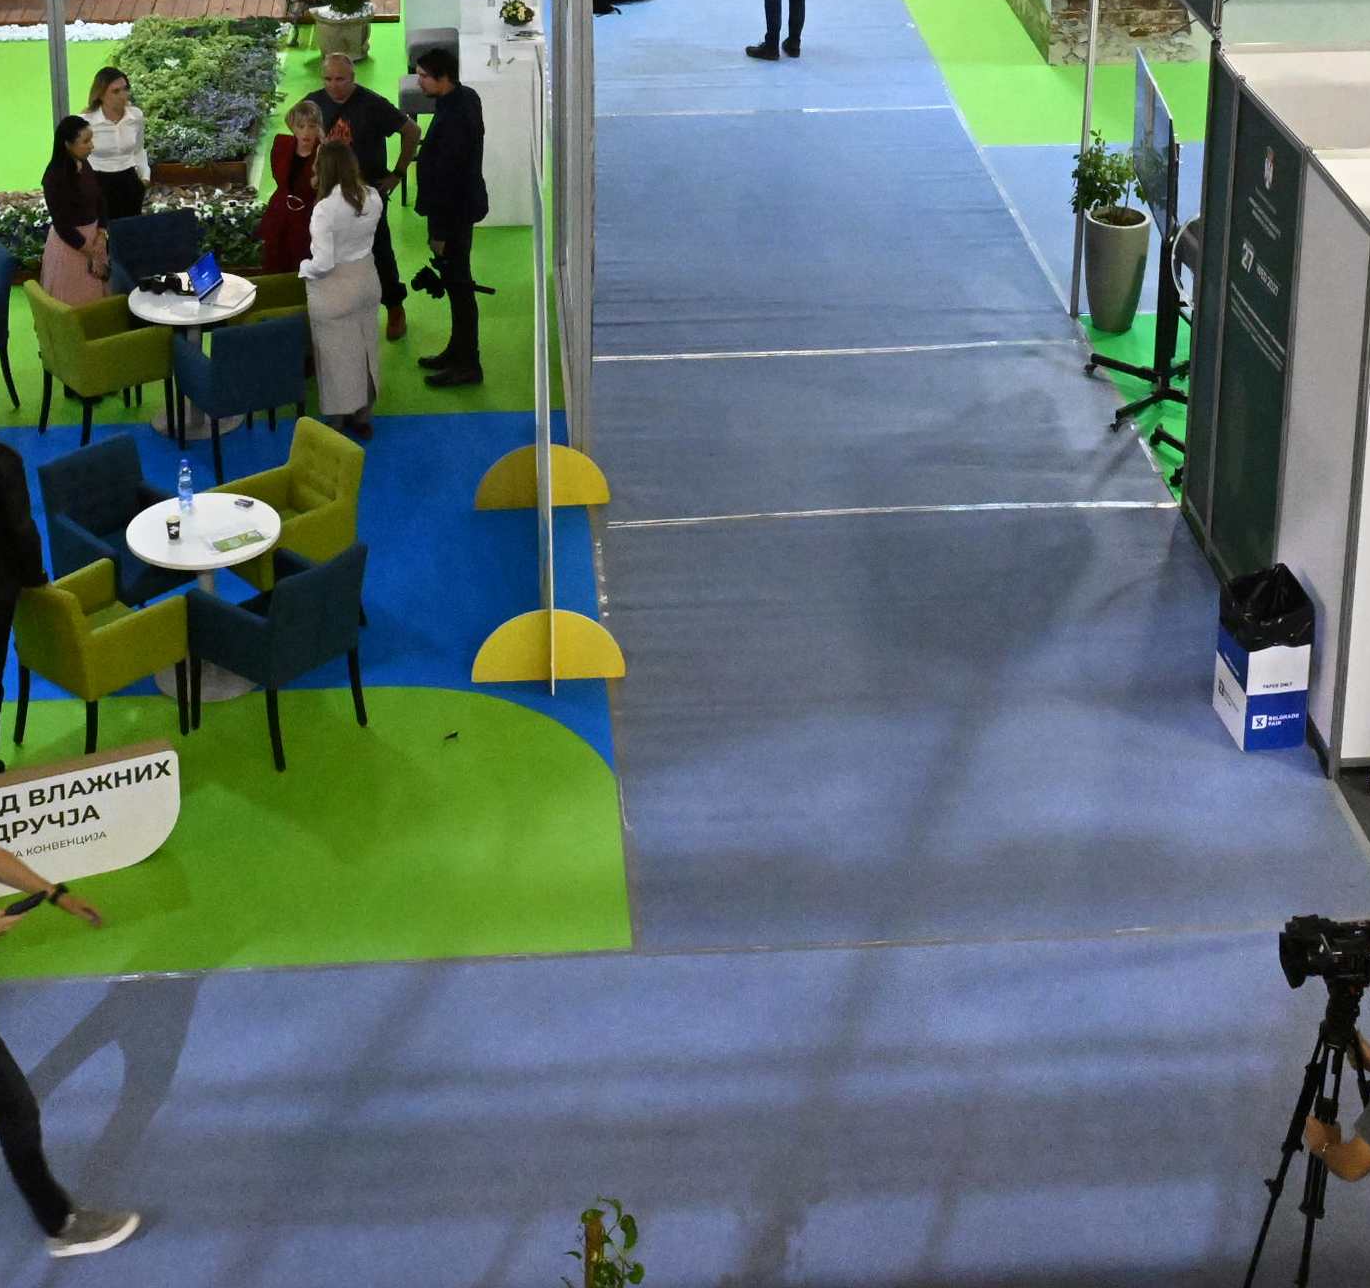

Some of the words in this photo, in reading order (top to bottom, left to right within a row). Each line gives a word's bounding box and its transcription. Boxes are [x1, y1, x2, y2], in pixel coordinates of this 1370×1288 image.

[1268, 713, 1300, 721] BELGRADE
[28, 759, 171, 807] ВЛАЖНИХ
[25, 830, 107, 858] КОНВЕНЦИЈА
